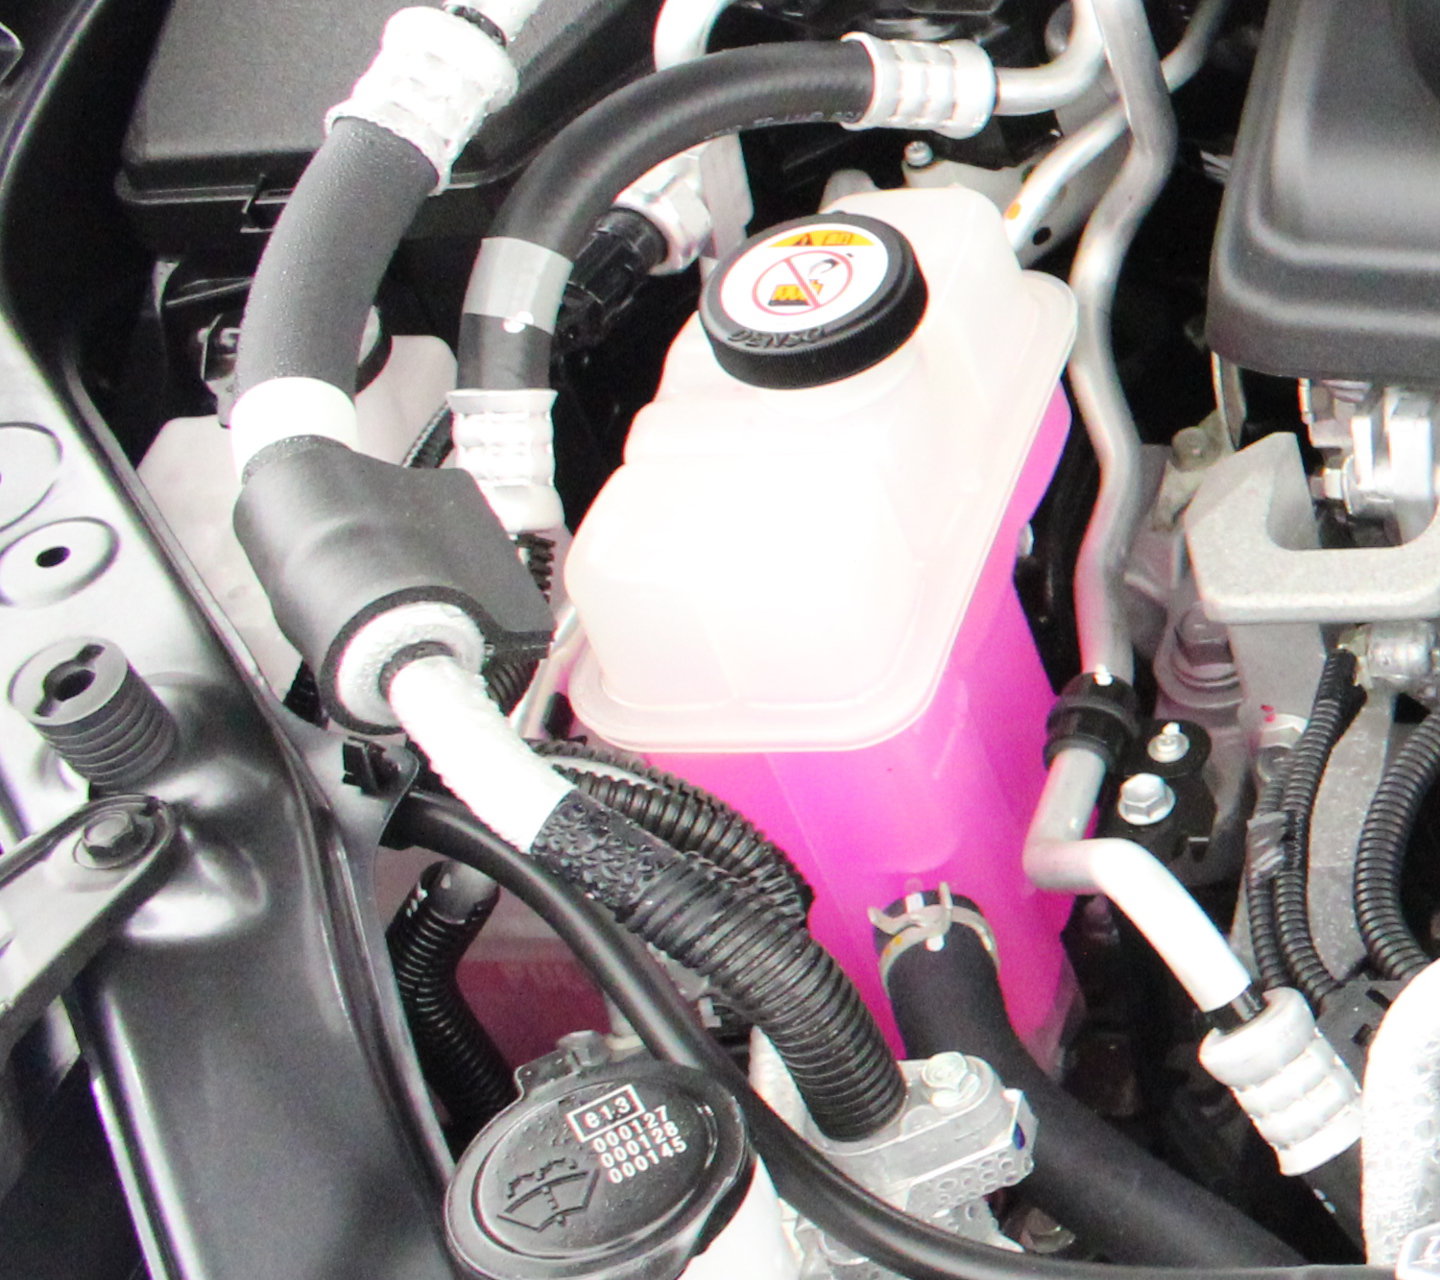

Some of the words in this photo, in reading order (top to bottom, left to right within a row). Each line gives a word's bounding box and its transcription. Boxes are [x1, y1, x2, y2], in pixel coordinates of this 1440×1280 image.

[591, 1104, 669, 1153] 000127
[599, 1120, 679, 1168] 000128
[607, 1135, 688, 1184] 000145
